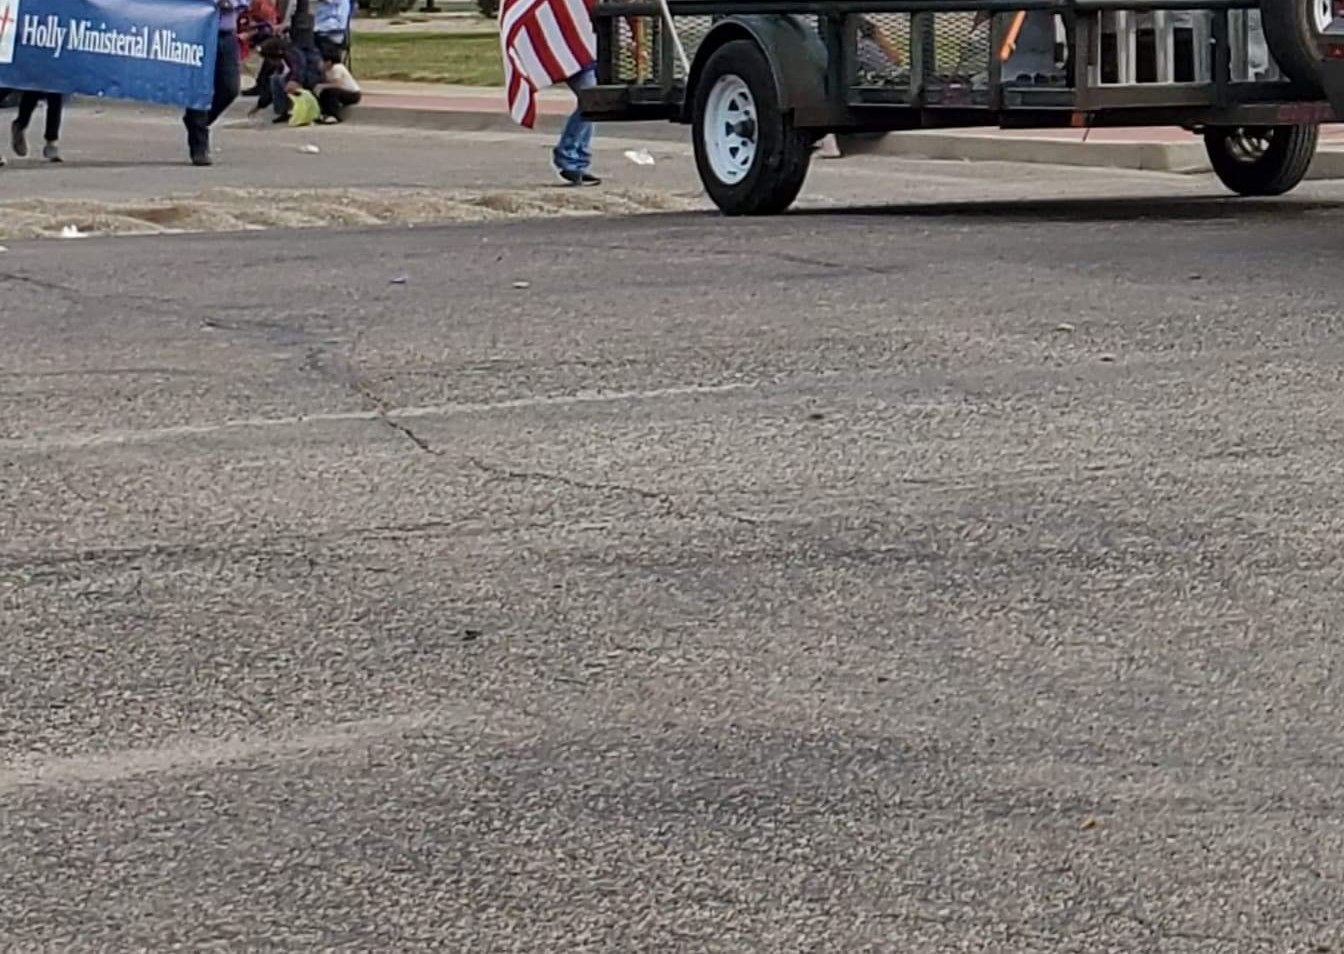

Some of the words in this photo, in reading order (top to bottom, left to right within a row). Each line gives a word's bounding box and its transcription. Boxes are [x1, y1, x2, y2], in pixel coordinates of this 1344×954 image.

[22, 13, 67, 58] Holly
[67, 18, 148, 58] Ministerial
[150, 27, 204, 66] Alliance
